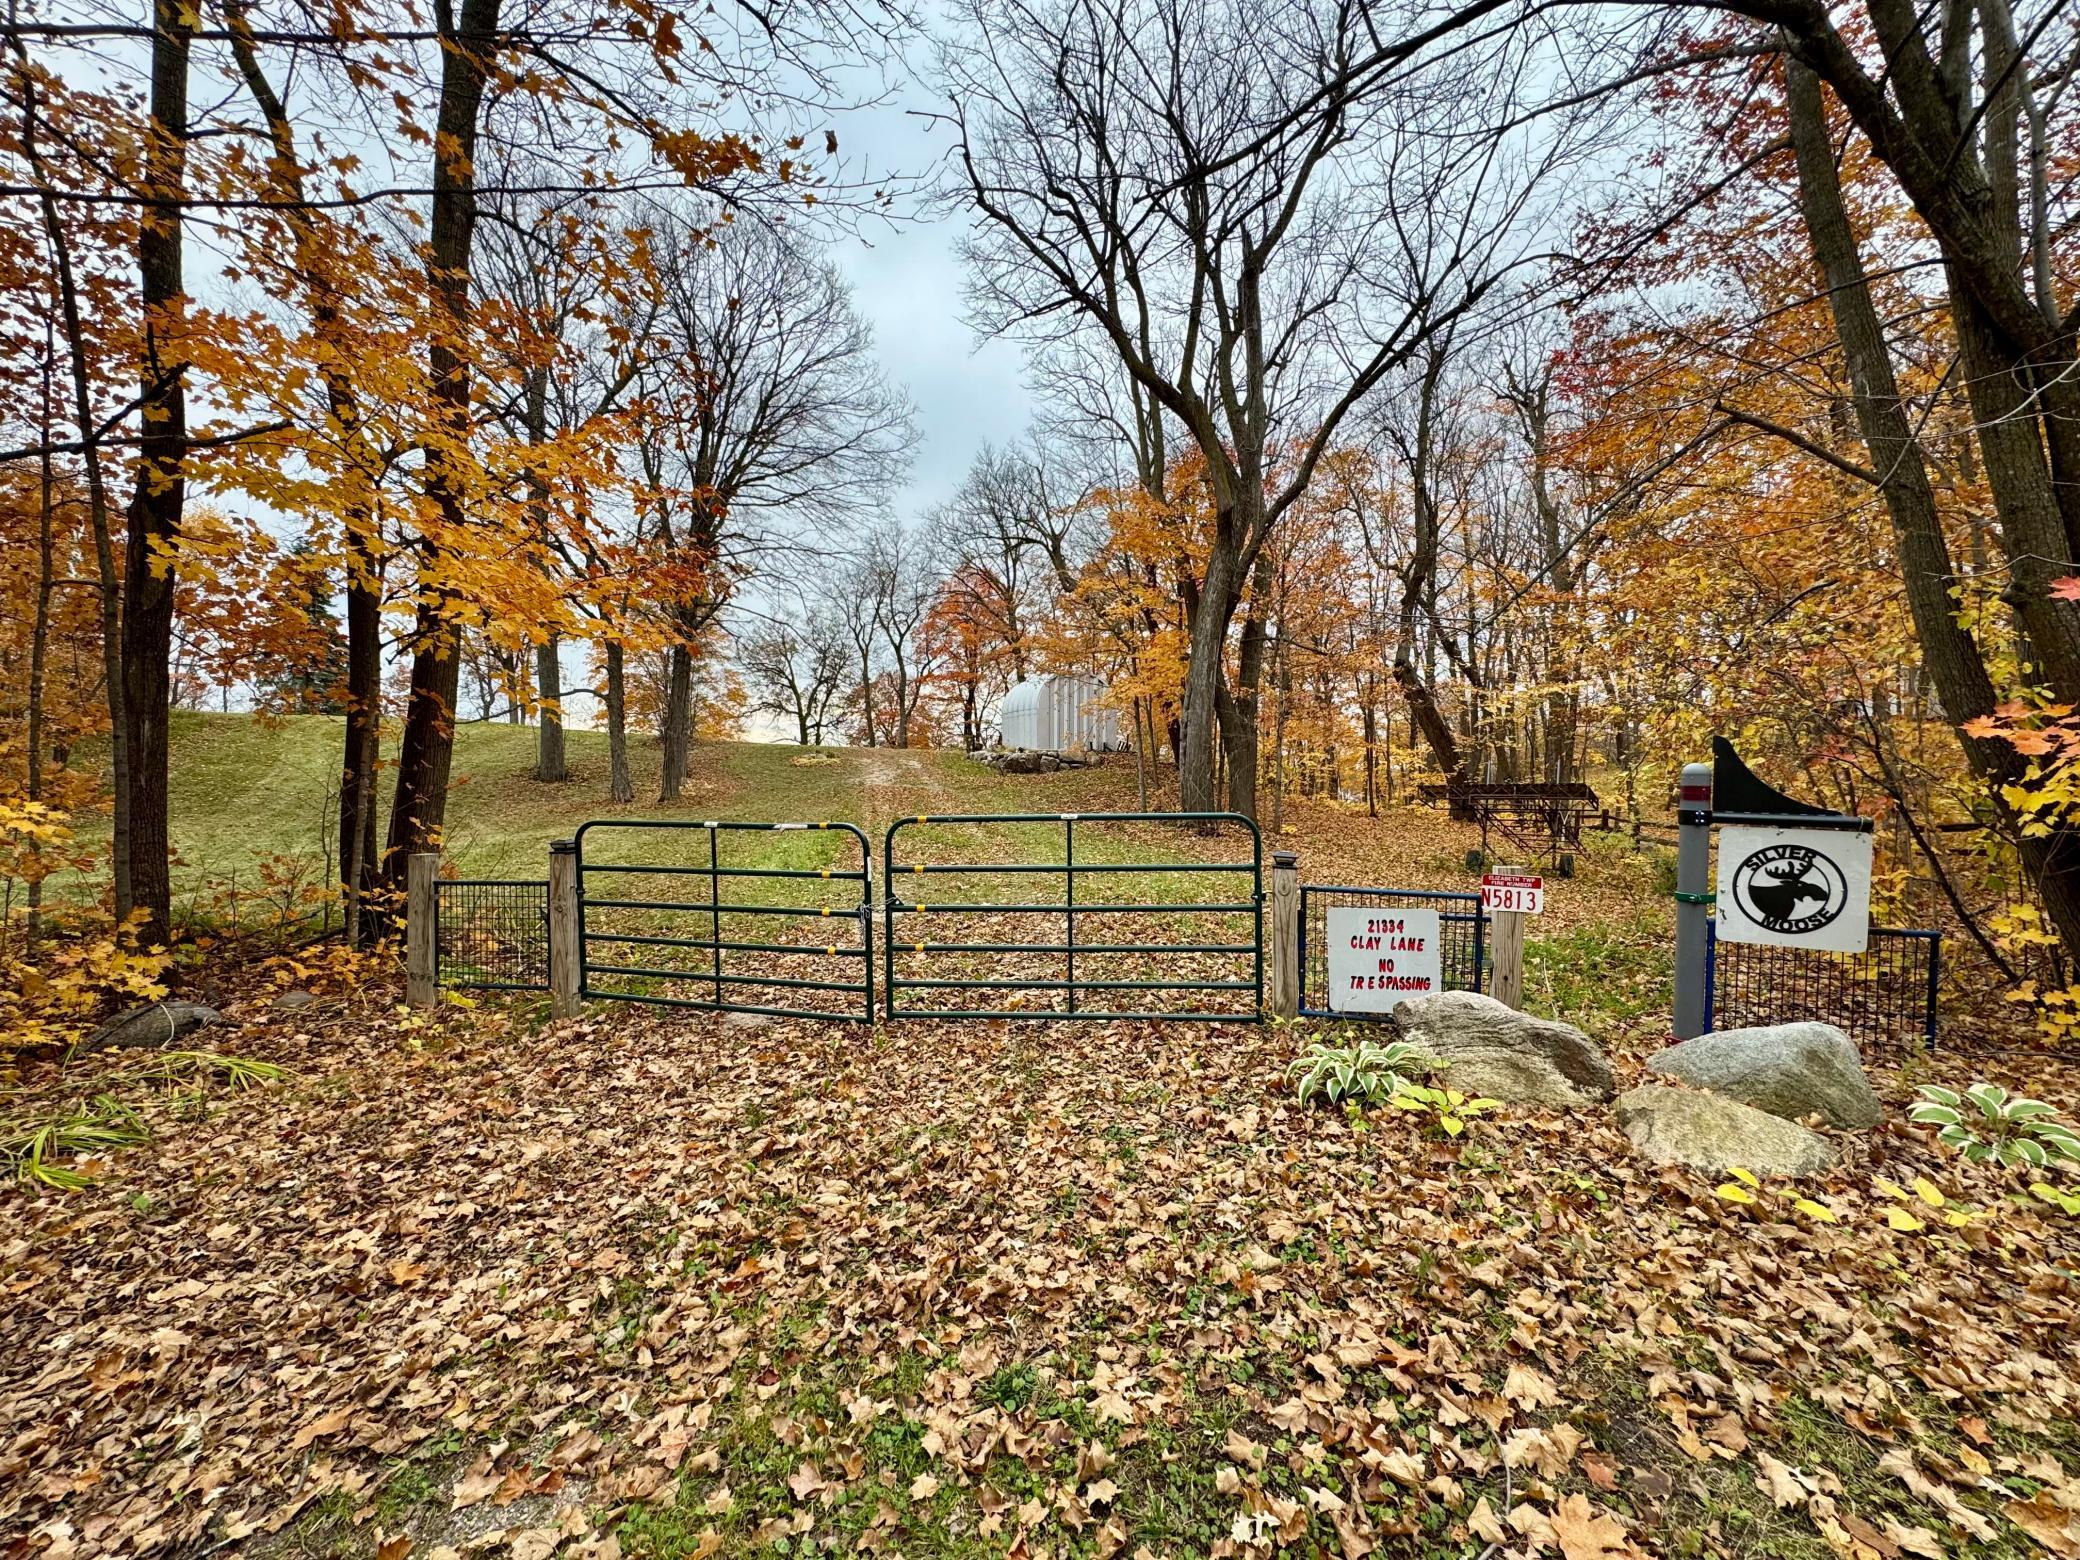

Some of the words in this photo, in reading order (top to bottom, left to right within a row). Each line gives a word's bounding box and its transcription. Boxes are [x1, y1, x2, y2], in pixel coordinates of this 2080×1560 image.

[1744, 846, 1817, 872] SILVER
[1481, 888, 1536, 911] N5813
[1367, 919, 1404, 933] 21334
[1760, 906, 1835, 932] MOOSE
[1350, 936, 1381, 950] CLAY
[1390, 937, 1425, 952] LANE
[1378, 958, 1395, 973] NO
